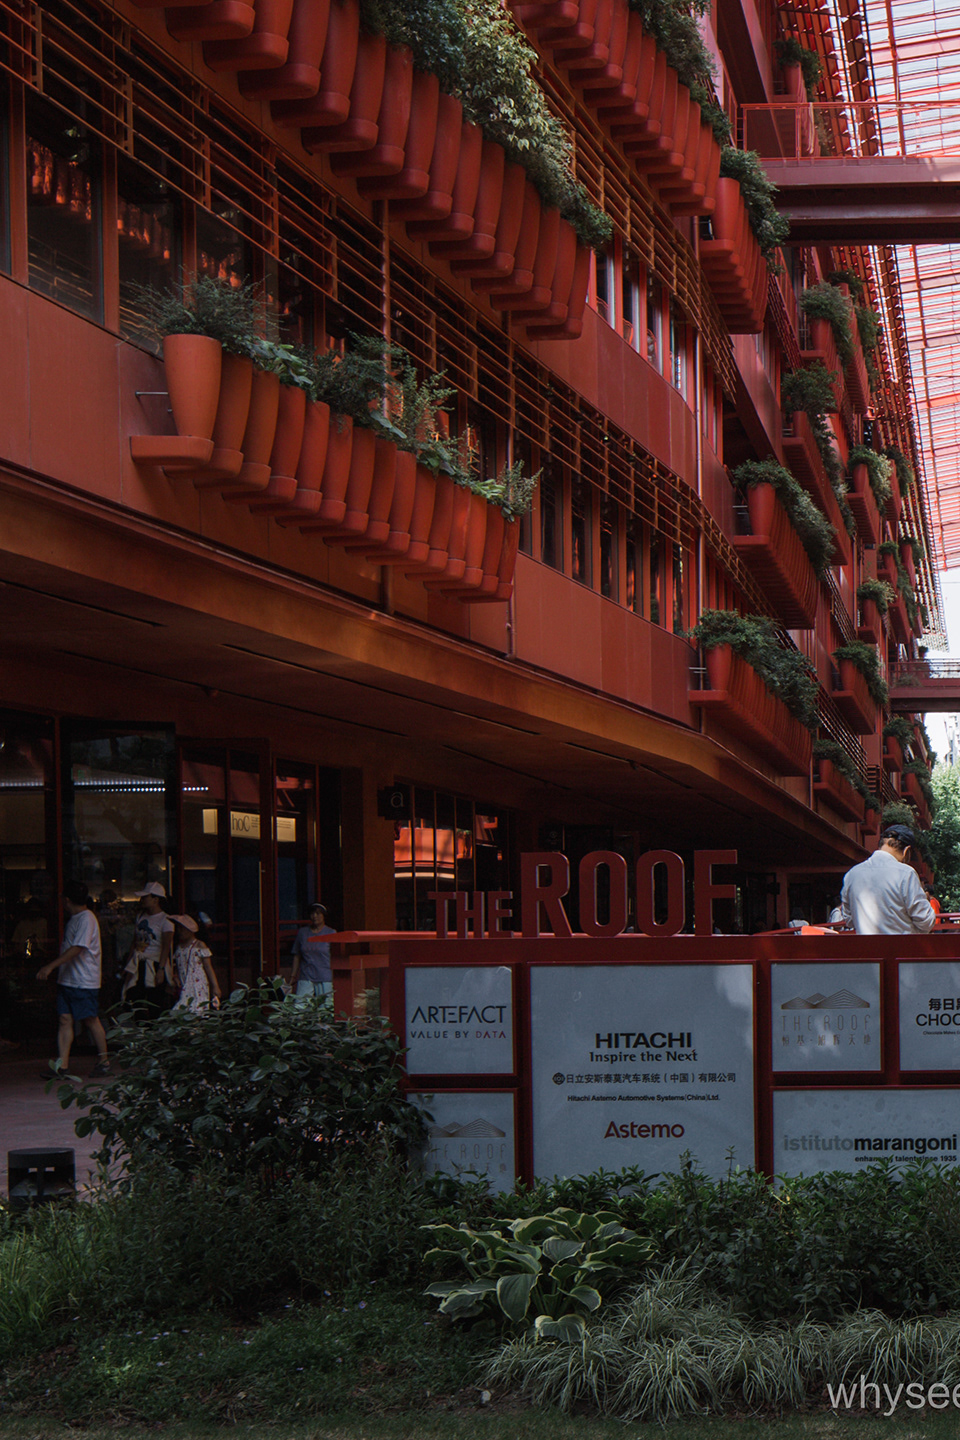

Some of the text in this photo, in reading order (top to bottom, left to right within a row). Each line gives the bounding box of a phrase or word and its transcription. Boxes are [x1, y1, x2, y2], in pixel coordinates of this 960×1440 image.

[427, 849, 738, 939] THE ROOF
[411, 1005, 507, 1023] ARTEFACT
[781, 1014, 871, 1031] THE ROOF
[410, 1030, 506, 1038] VALUE BY DATA
[595, 1032, 692, 1048] HITACHI
[589, 1049, 698, 1064] Inspire the Next
[604, 1121, 685, 1138] Astemo
[459, 1143, 506, 1160] ROOF
